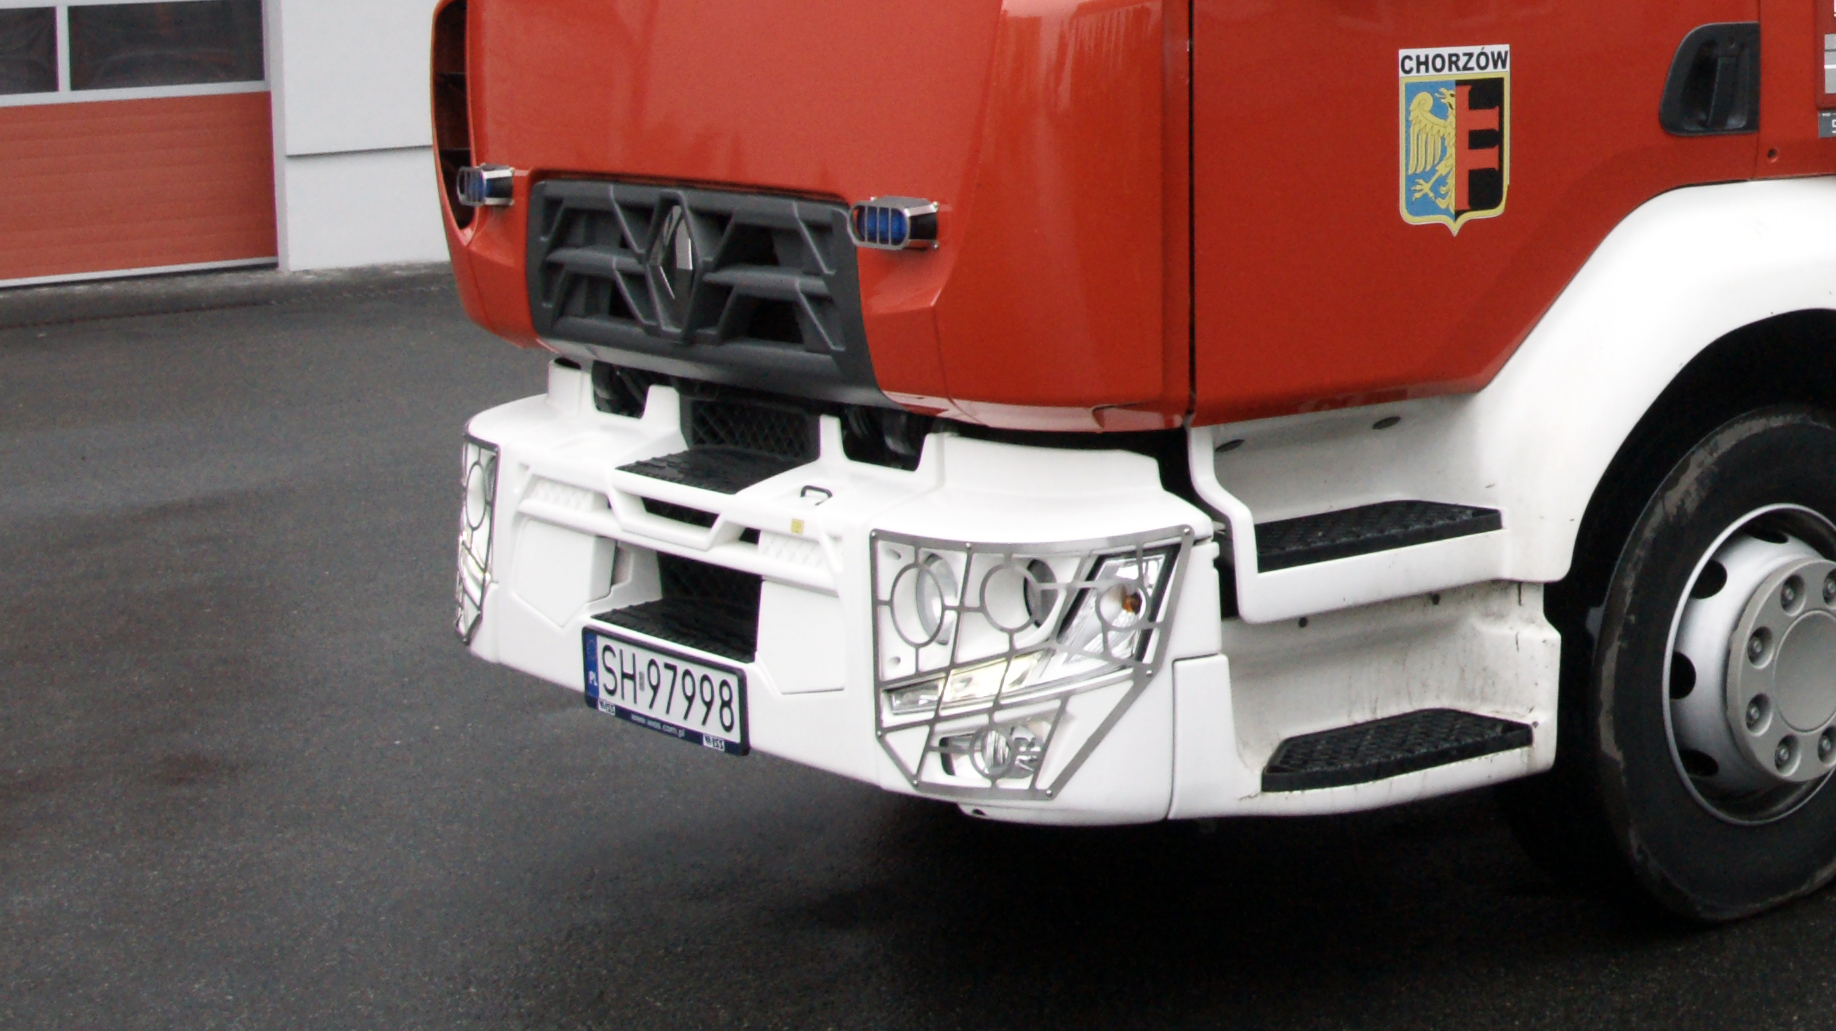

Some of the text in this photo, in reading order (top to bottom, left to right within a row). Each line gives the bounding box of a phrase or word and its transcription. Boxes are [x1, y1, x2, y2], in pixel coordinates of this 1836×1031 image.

[1400, 47, 1509, 75] CHORZÓW
[588, 670, 598, 687] PL
[601, 644, 735, 733] SH 97998
